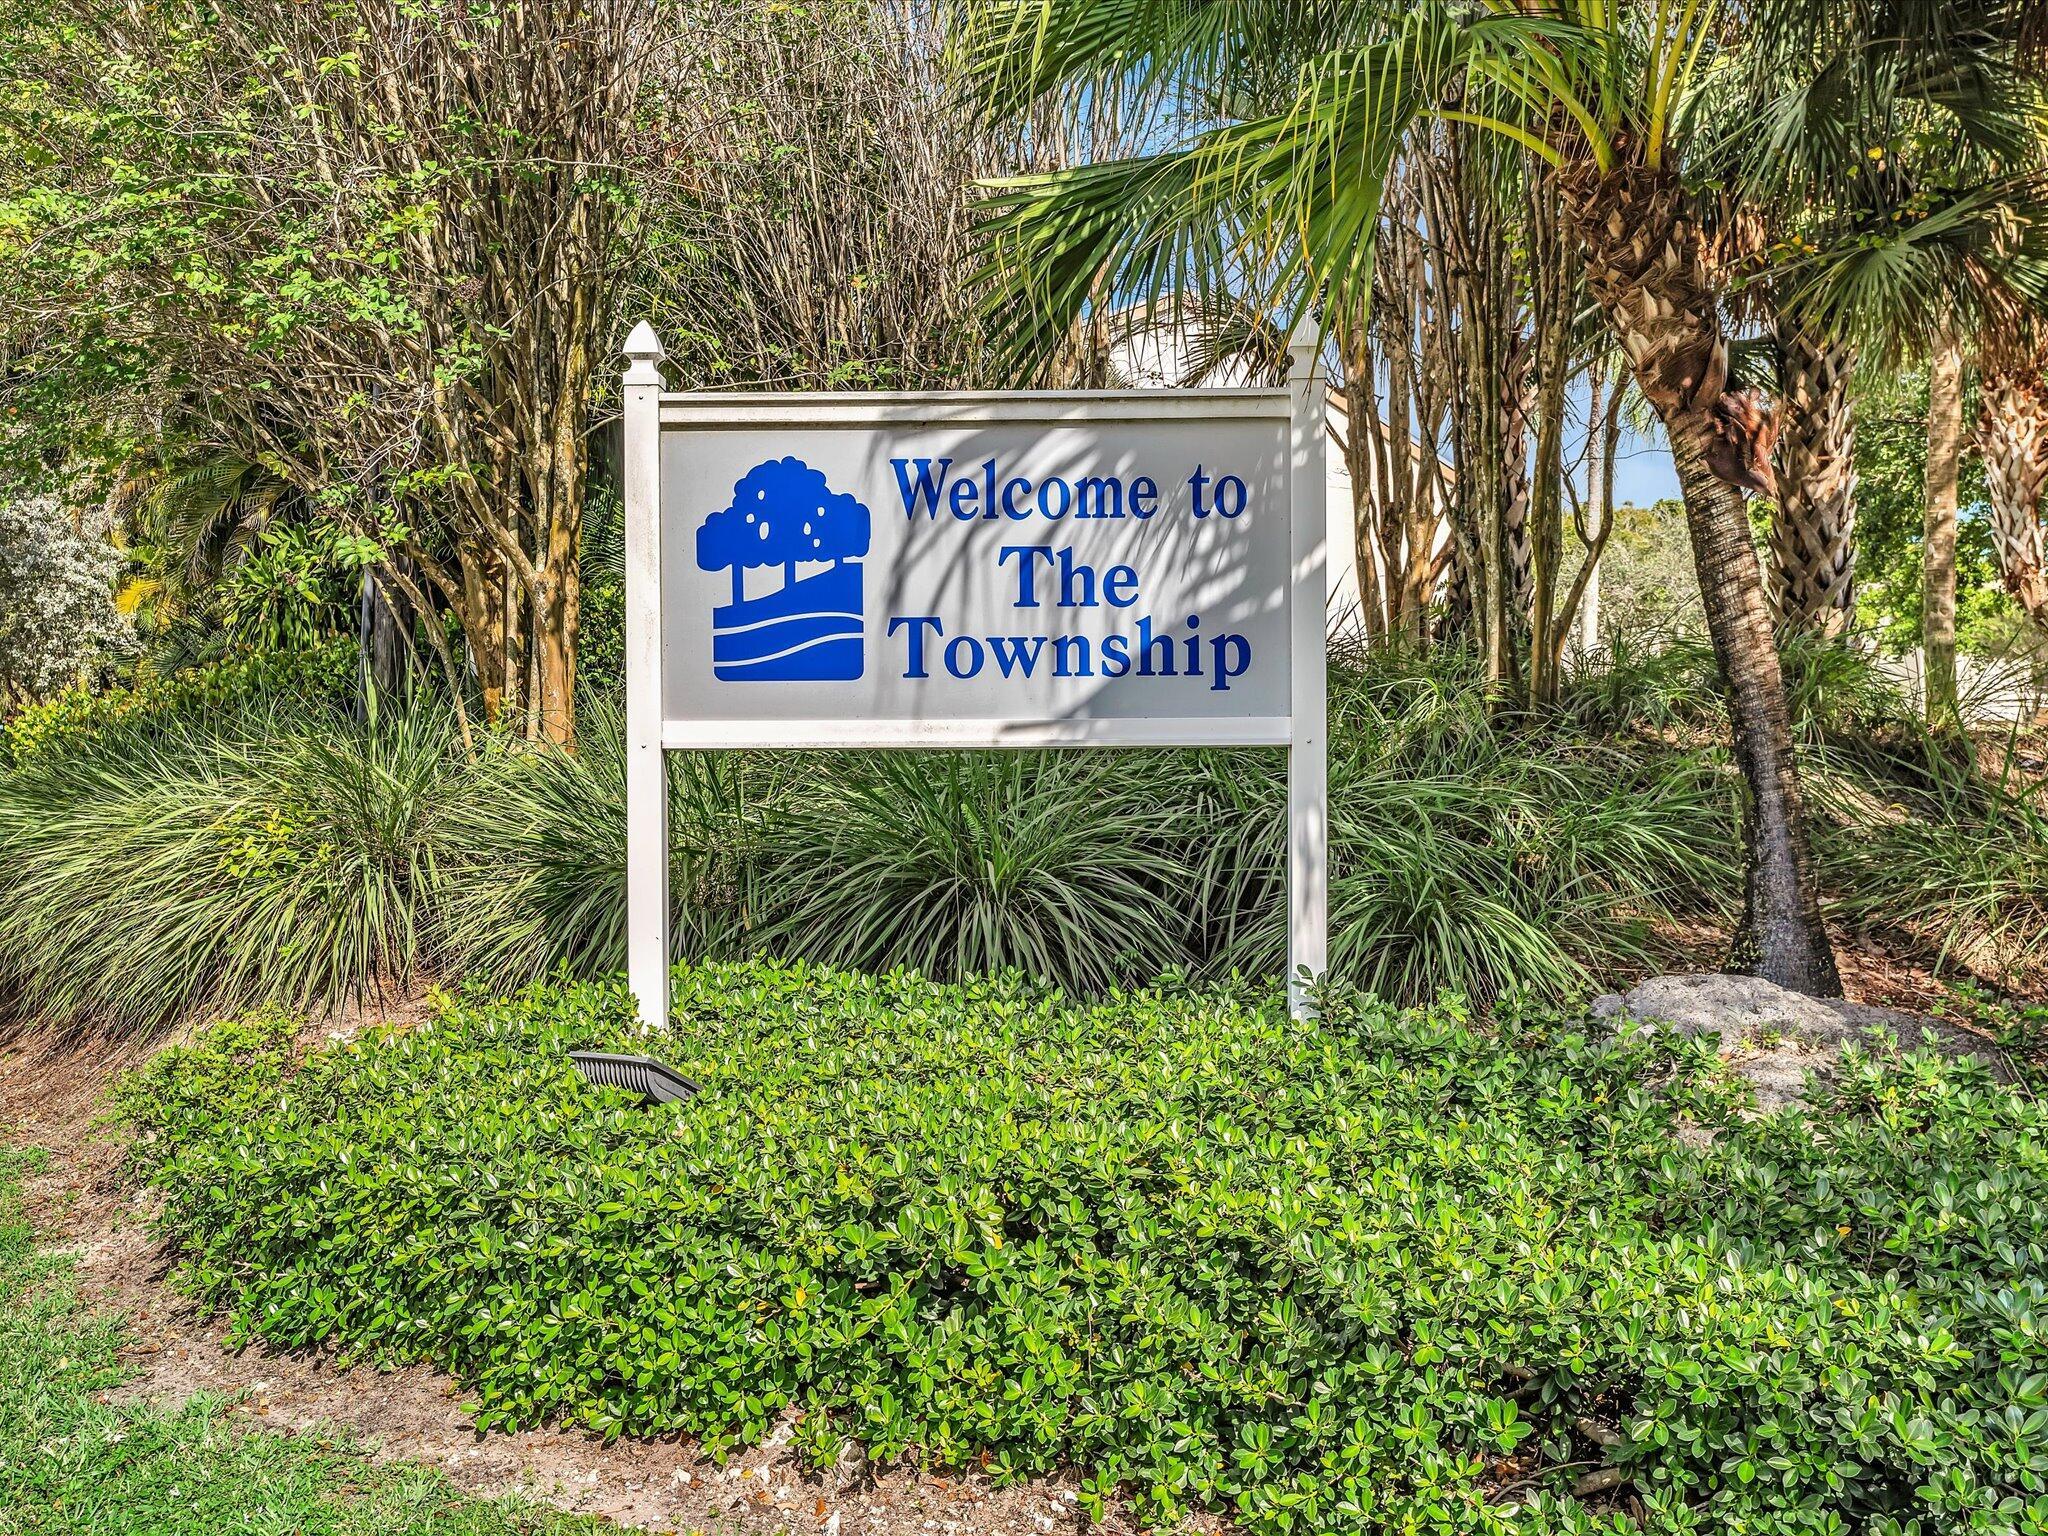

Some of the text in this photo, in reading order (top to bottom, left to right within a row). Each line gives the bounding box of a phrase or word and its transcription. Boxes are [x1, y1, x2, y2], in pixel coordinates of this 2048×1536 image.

[889, 457, 1248, 521] Welcome to
[998, 545, 1140, 609] The
[887, 615, 1252, 691] Township
